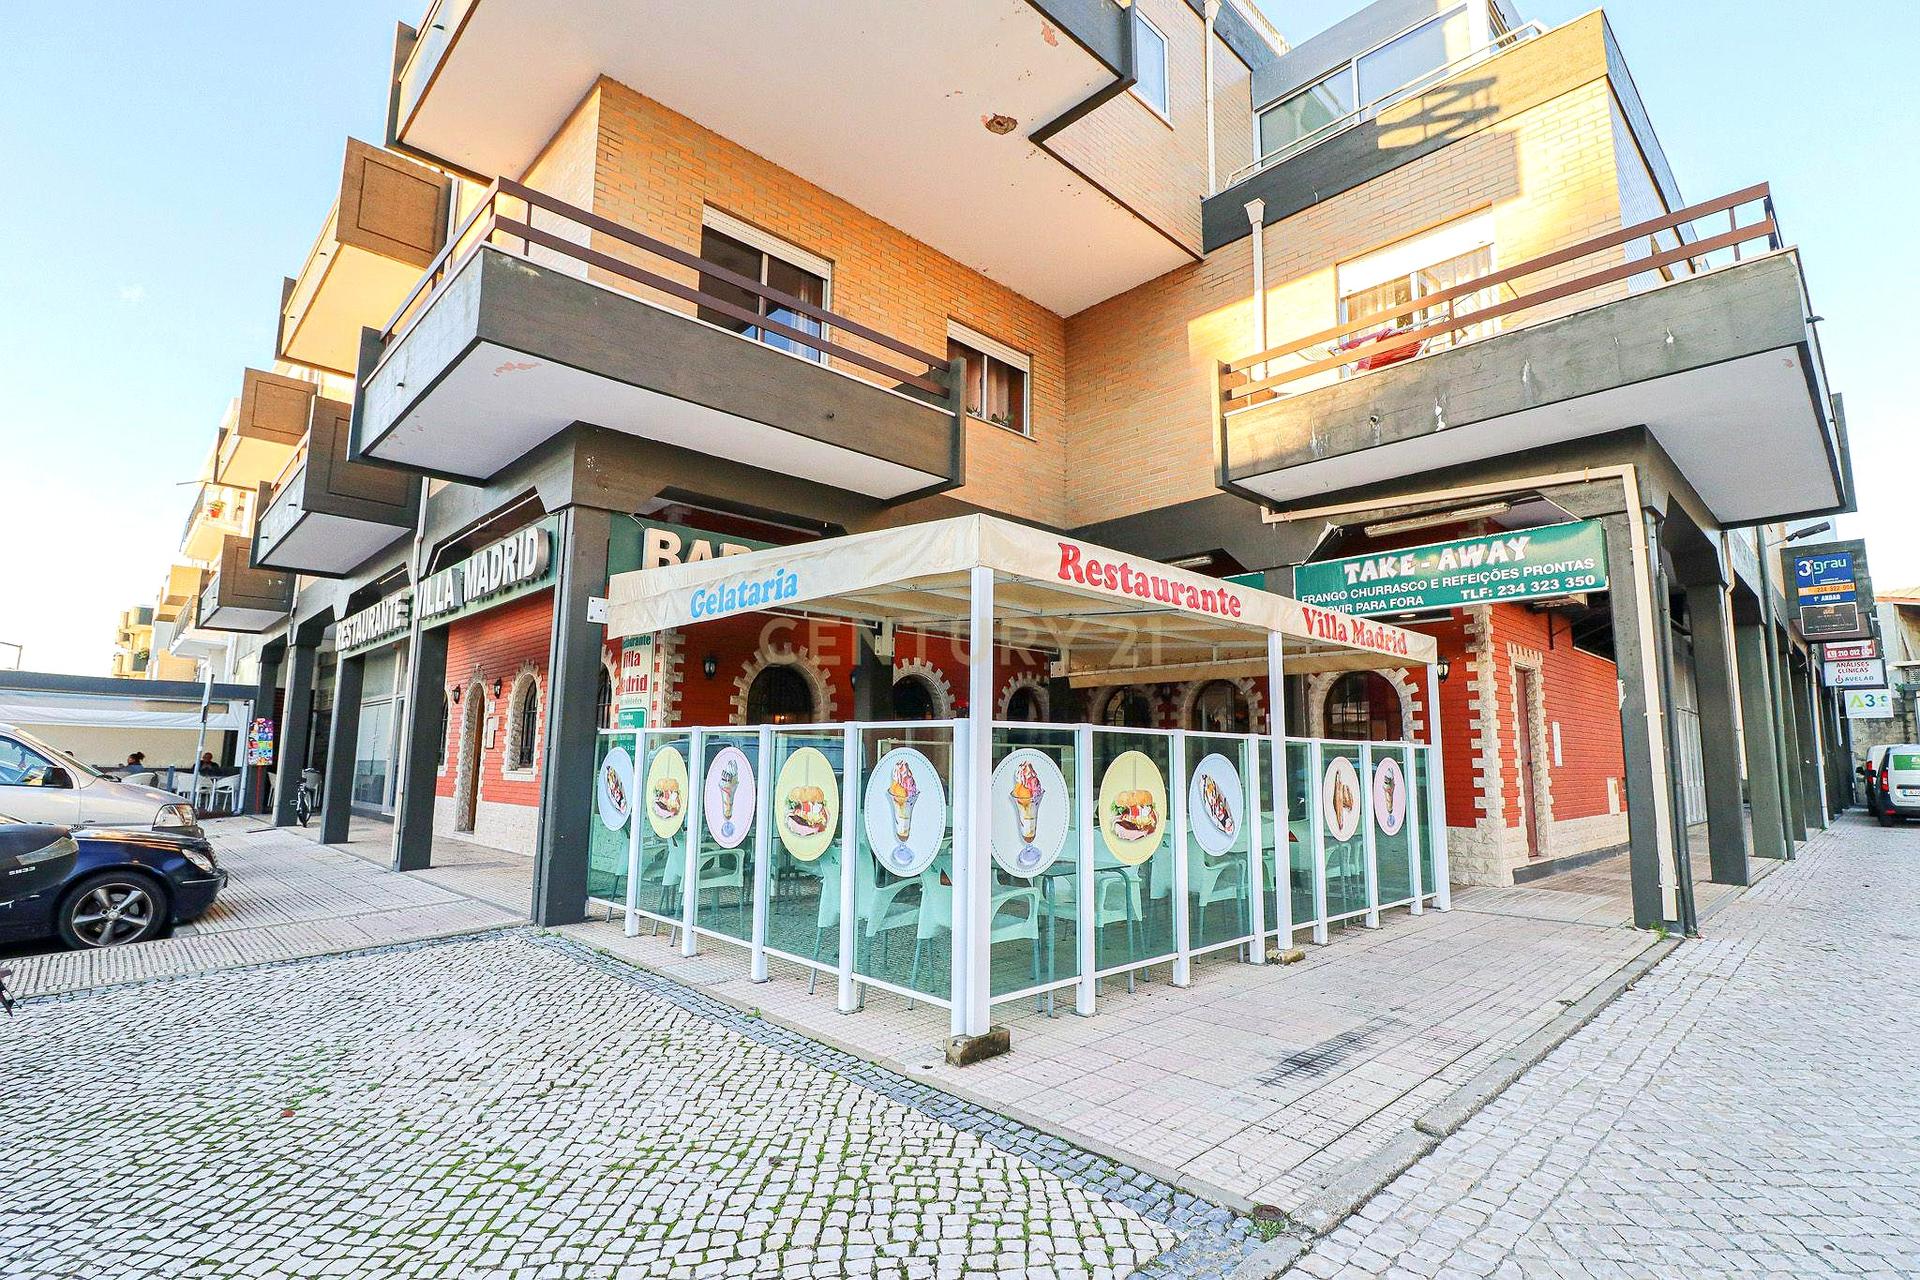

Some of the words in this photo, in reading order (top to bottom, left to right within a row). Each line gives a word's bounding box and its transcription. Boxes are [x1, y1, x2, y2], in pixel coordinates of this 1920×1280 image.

[416, 567, 463, 620] VILLA
[463, 527, 550, 603] MADRID
[689, 567, 799, 619] Gelataria
[1057, 541, 1241, 618] Restaurante
[1301, 606, 1348, 643] Villa
[1352, 617, 1408, 656] Madrid
[1301, 591, 1348, 604] FRANGO
[1351, 579, 1428, 599] CHURRASCO
[1430, 577, 1439, 588] E
[1442, 568, 1520, 587] REFEIÇÕES
[1523, 557, 1595, 579] PRONTAS
[1460, 587, 1493, 601] TLF:
[1497, 583, 1525, 597] 234
[1531, 578, 1560, 594] 323
[1565, 574, 1595, 589] 350
[335, 592, 409, 652] RESTAURANTE
[1356, 601, 1387, 613] PARA
[1390, 595, 1424, 608] FORA
